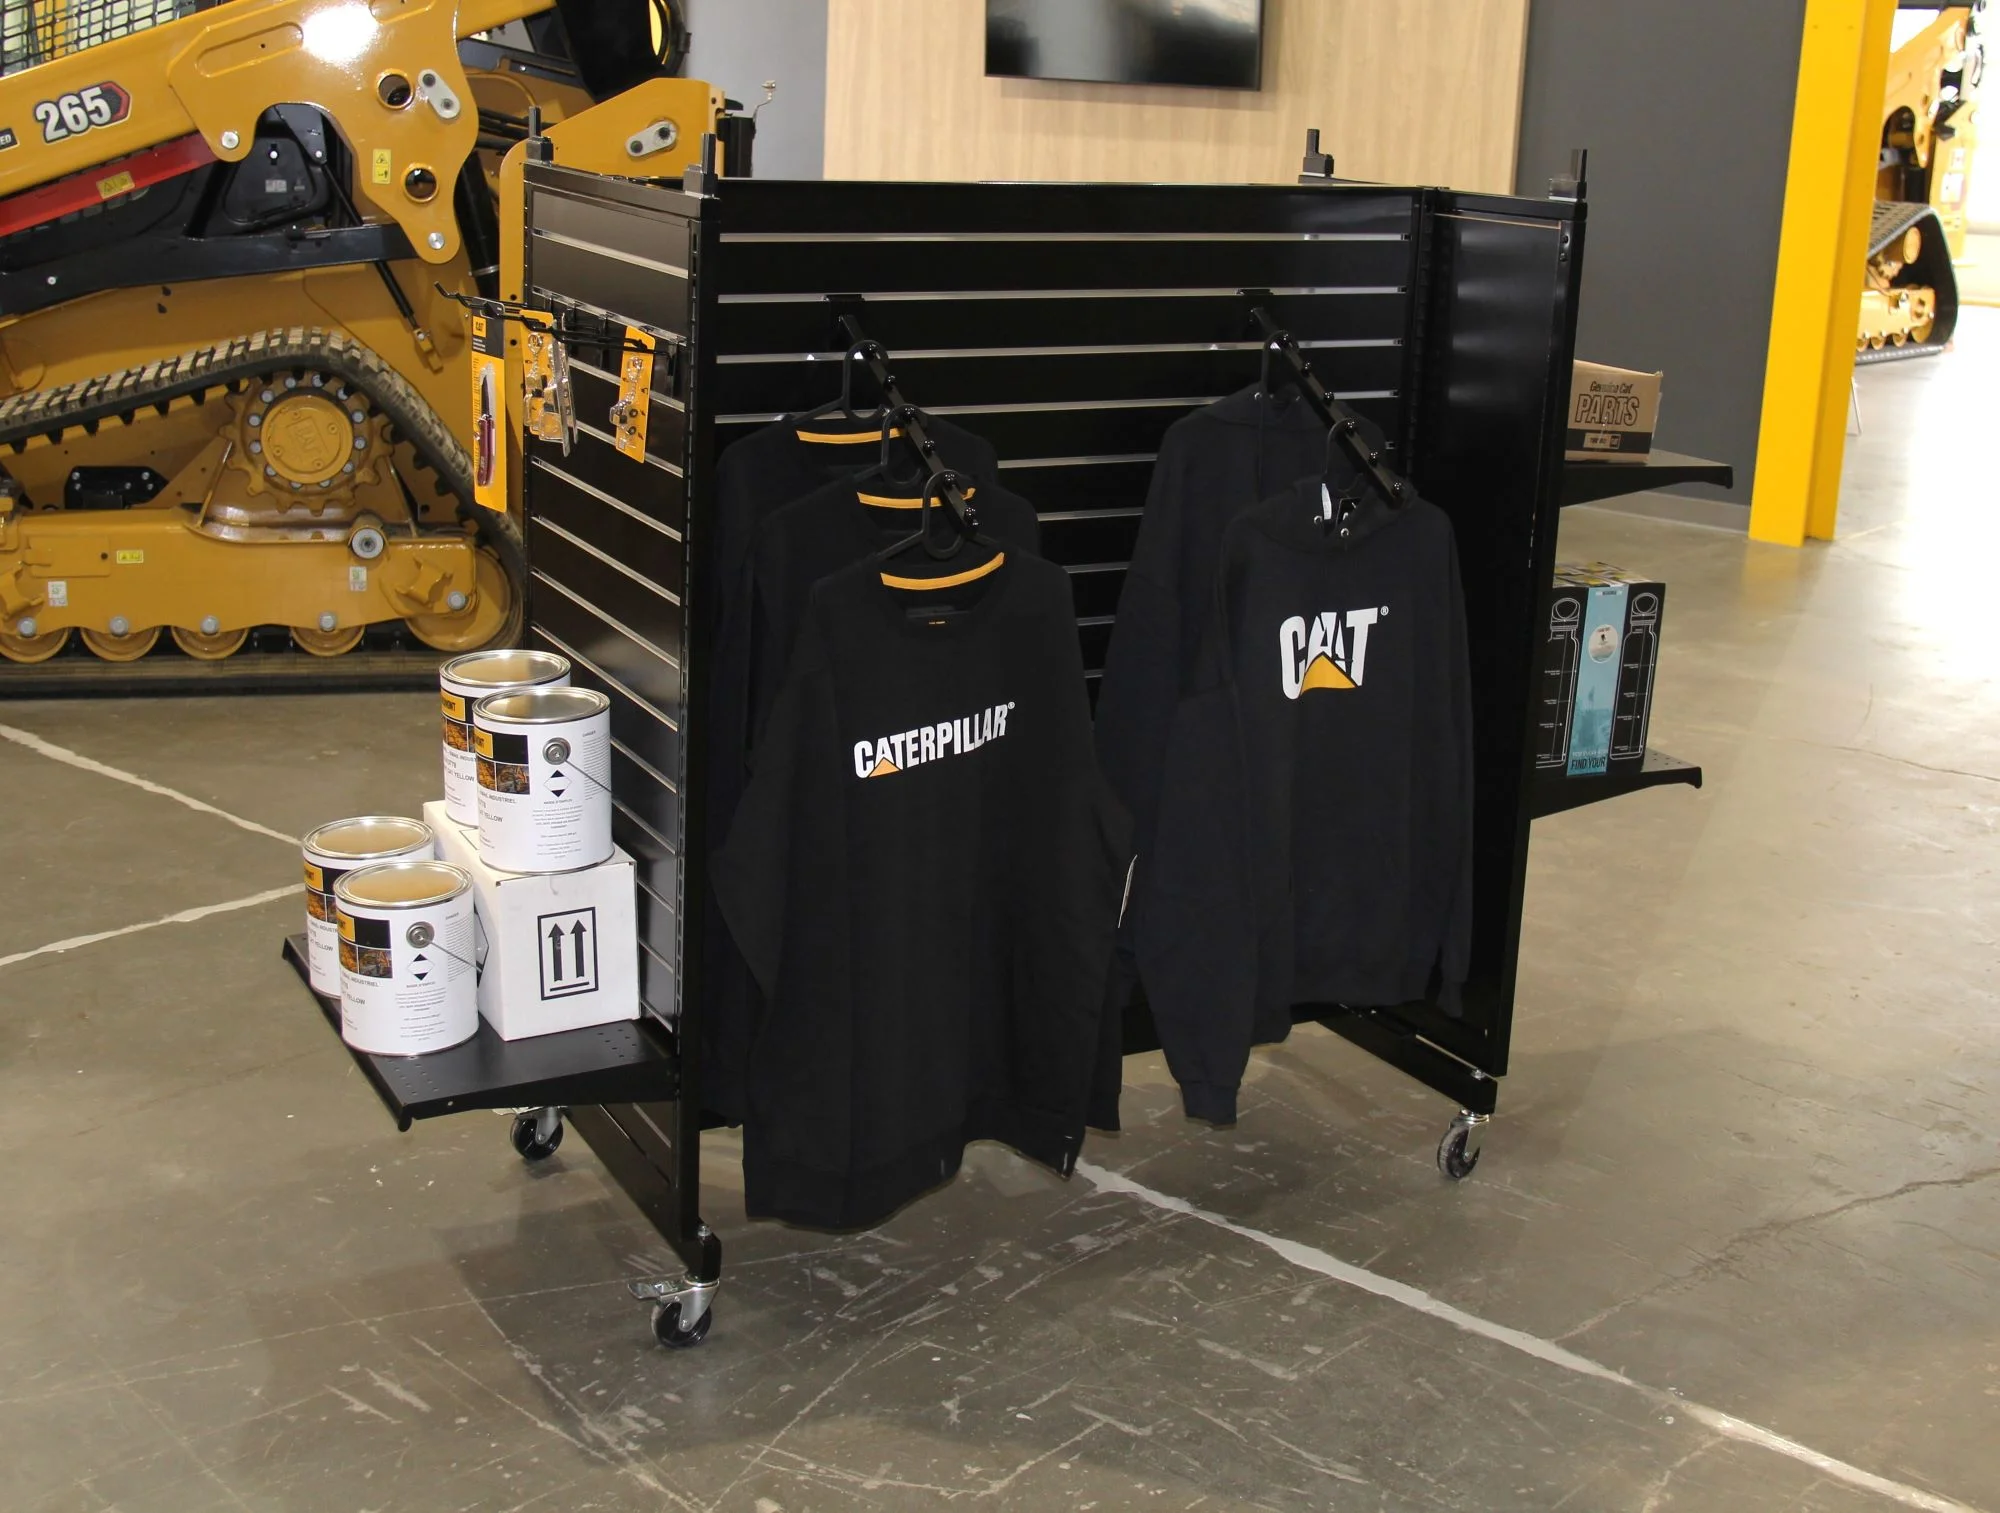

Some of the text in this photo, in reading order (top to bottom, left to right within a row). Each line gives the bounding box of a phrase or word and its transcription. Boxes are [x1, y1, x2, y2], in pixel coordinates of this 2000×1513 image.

[35, 86, 112, 142] 265
[1590, 381, 1634, 394] Genuine Cat
[1574, 393, 1641, 427] PARTS
[454, 771, 475, 783] YELLOW
